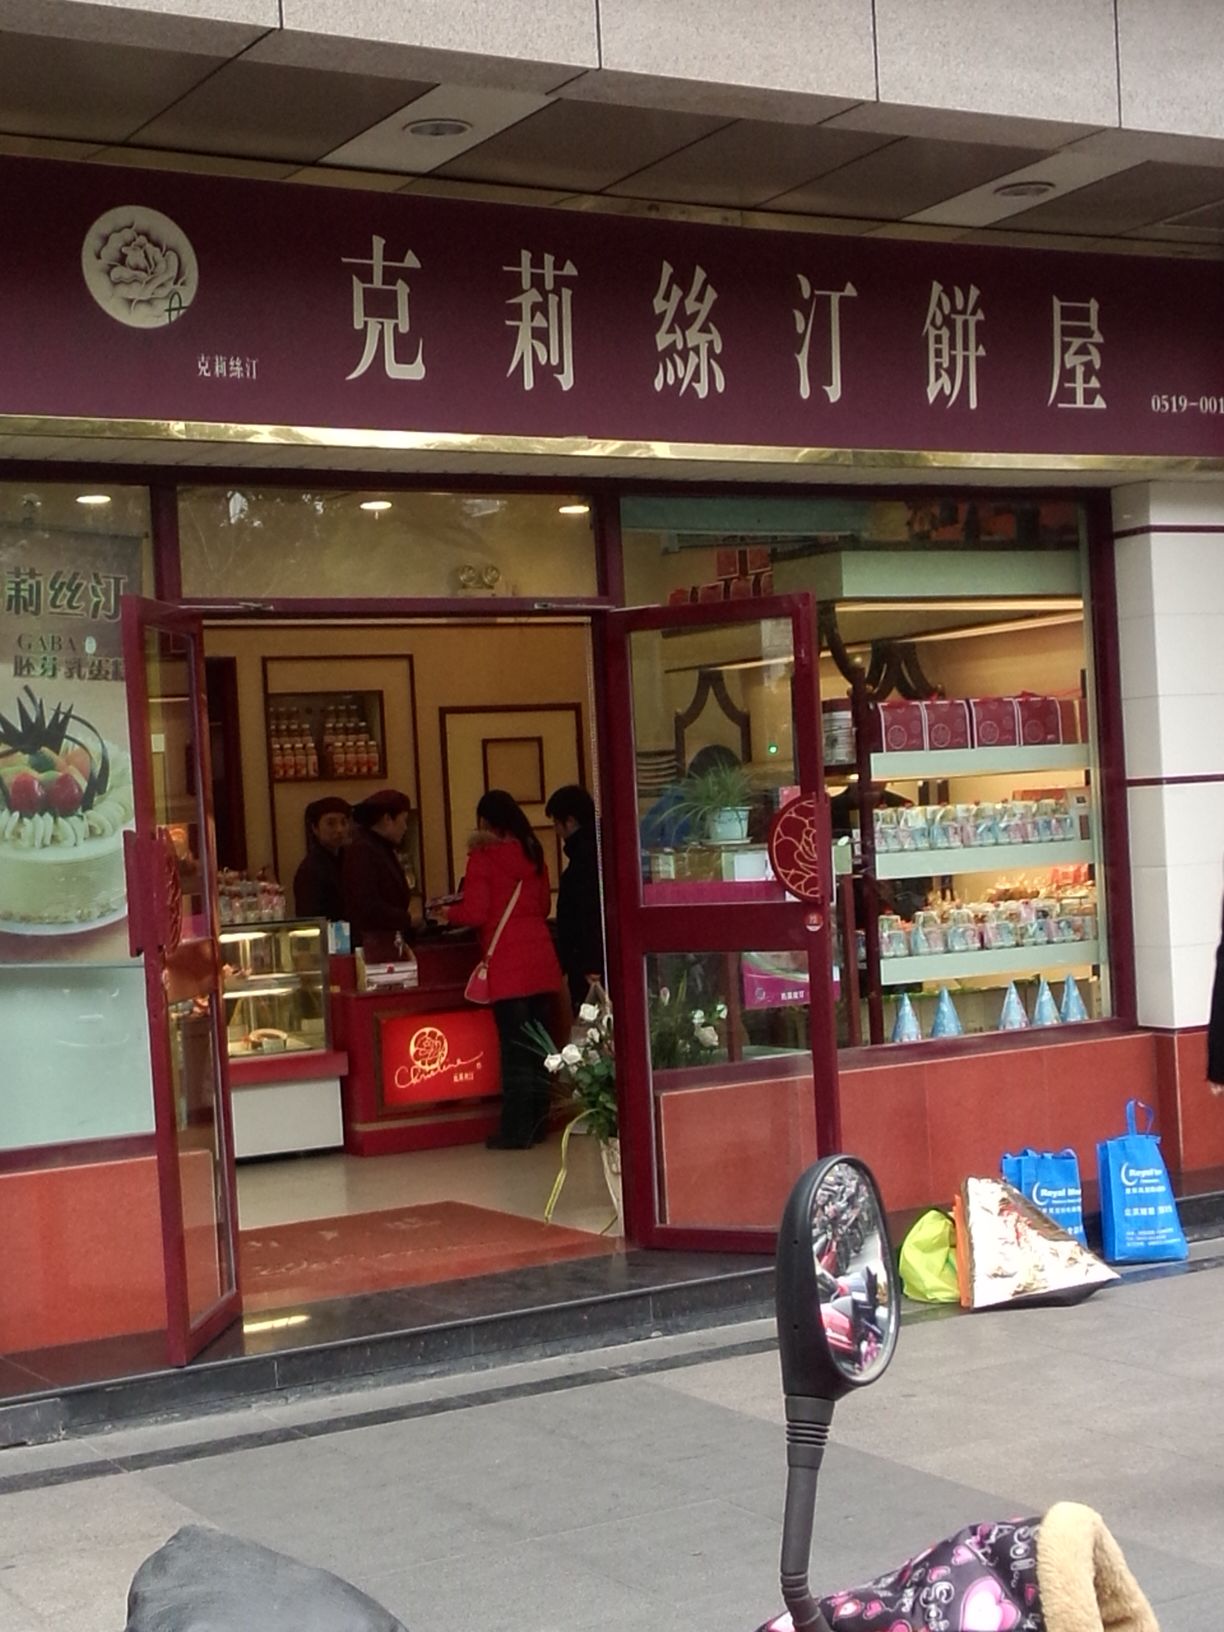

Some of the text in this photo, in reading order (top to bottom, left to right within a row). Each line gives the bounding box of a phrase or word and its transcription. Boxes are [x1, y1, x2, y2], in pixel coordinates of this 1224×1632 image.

[341, 234, 1108, 411] 克莉絲汀餅屋
[17, 633, 77, 652] GABA
